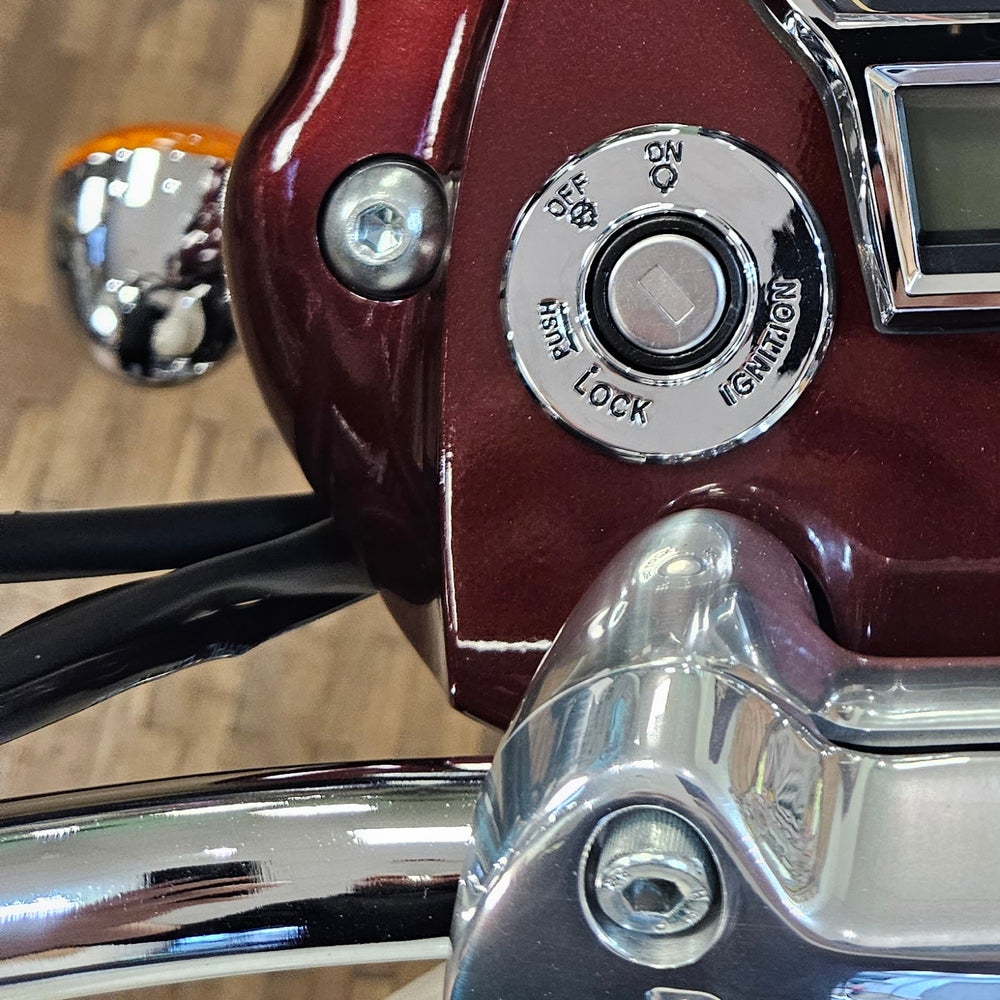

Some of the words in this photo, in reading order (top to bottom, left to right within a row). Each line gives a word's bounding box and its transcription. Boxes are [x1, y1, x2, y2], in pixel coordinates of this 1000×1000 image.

[643, 140, 684, 164] ON
[543, 170, 590, 219] OFF
[537, 298, 572, 361] PUSH
[718, 277, 801, 407] IGNITION
[572, 365, 653, 427] LOCK
